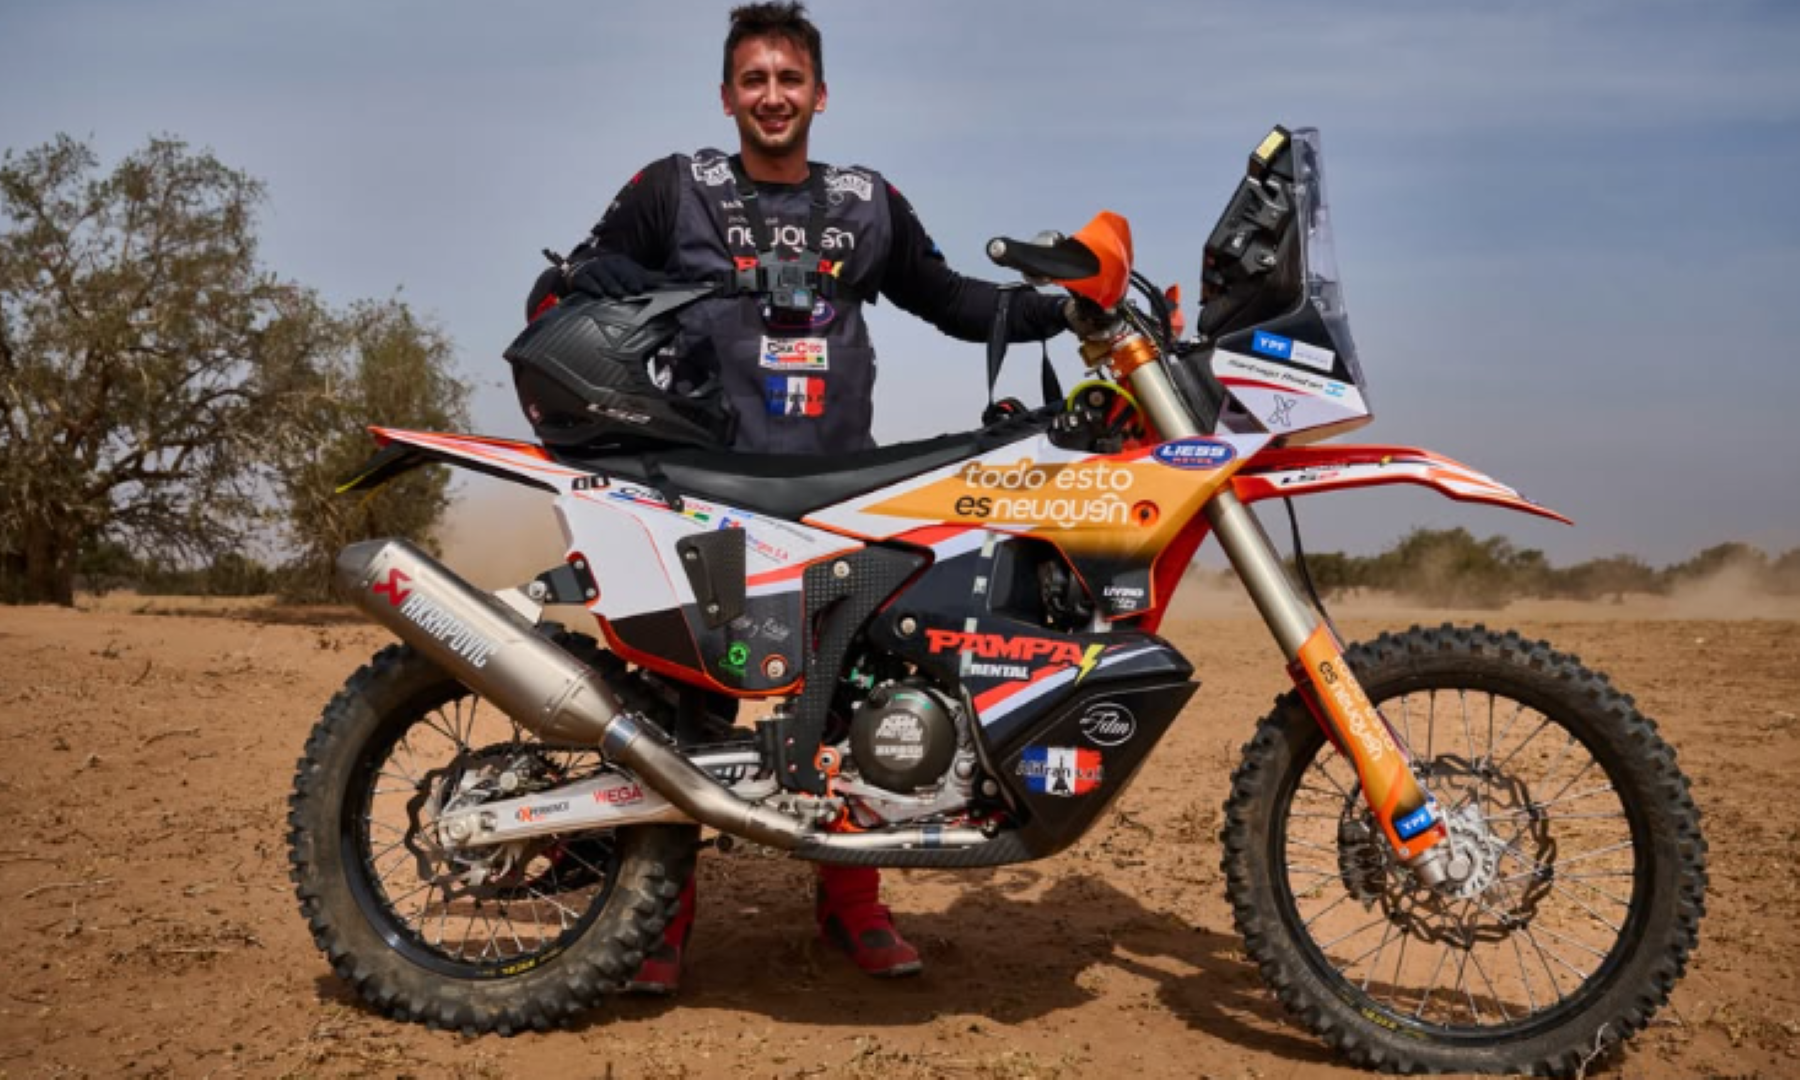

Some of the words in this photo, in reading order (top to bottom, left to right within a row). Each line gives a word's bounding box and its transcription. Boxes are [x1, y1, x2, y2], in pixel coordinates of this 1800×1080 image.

[1260, 337, 1287, 351] YPF
[1161, 445, 1226, 457] LIESS
[965, 457, 1047, 489] todo
[1056, 466, 1134, 490] esto
[925, 628, 1083, 664] PAMPA
[970, 663, 1029, 680] RENTAL
[594, 783, 643, 803] WEGA
[1403, 812, 1427, 830] YPF
